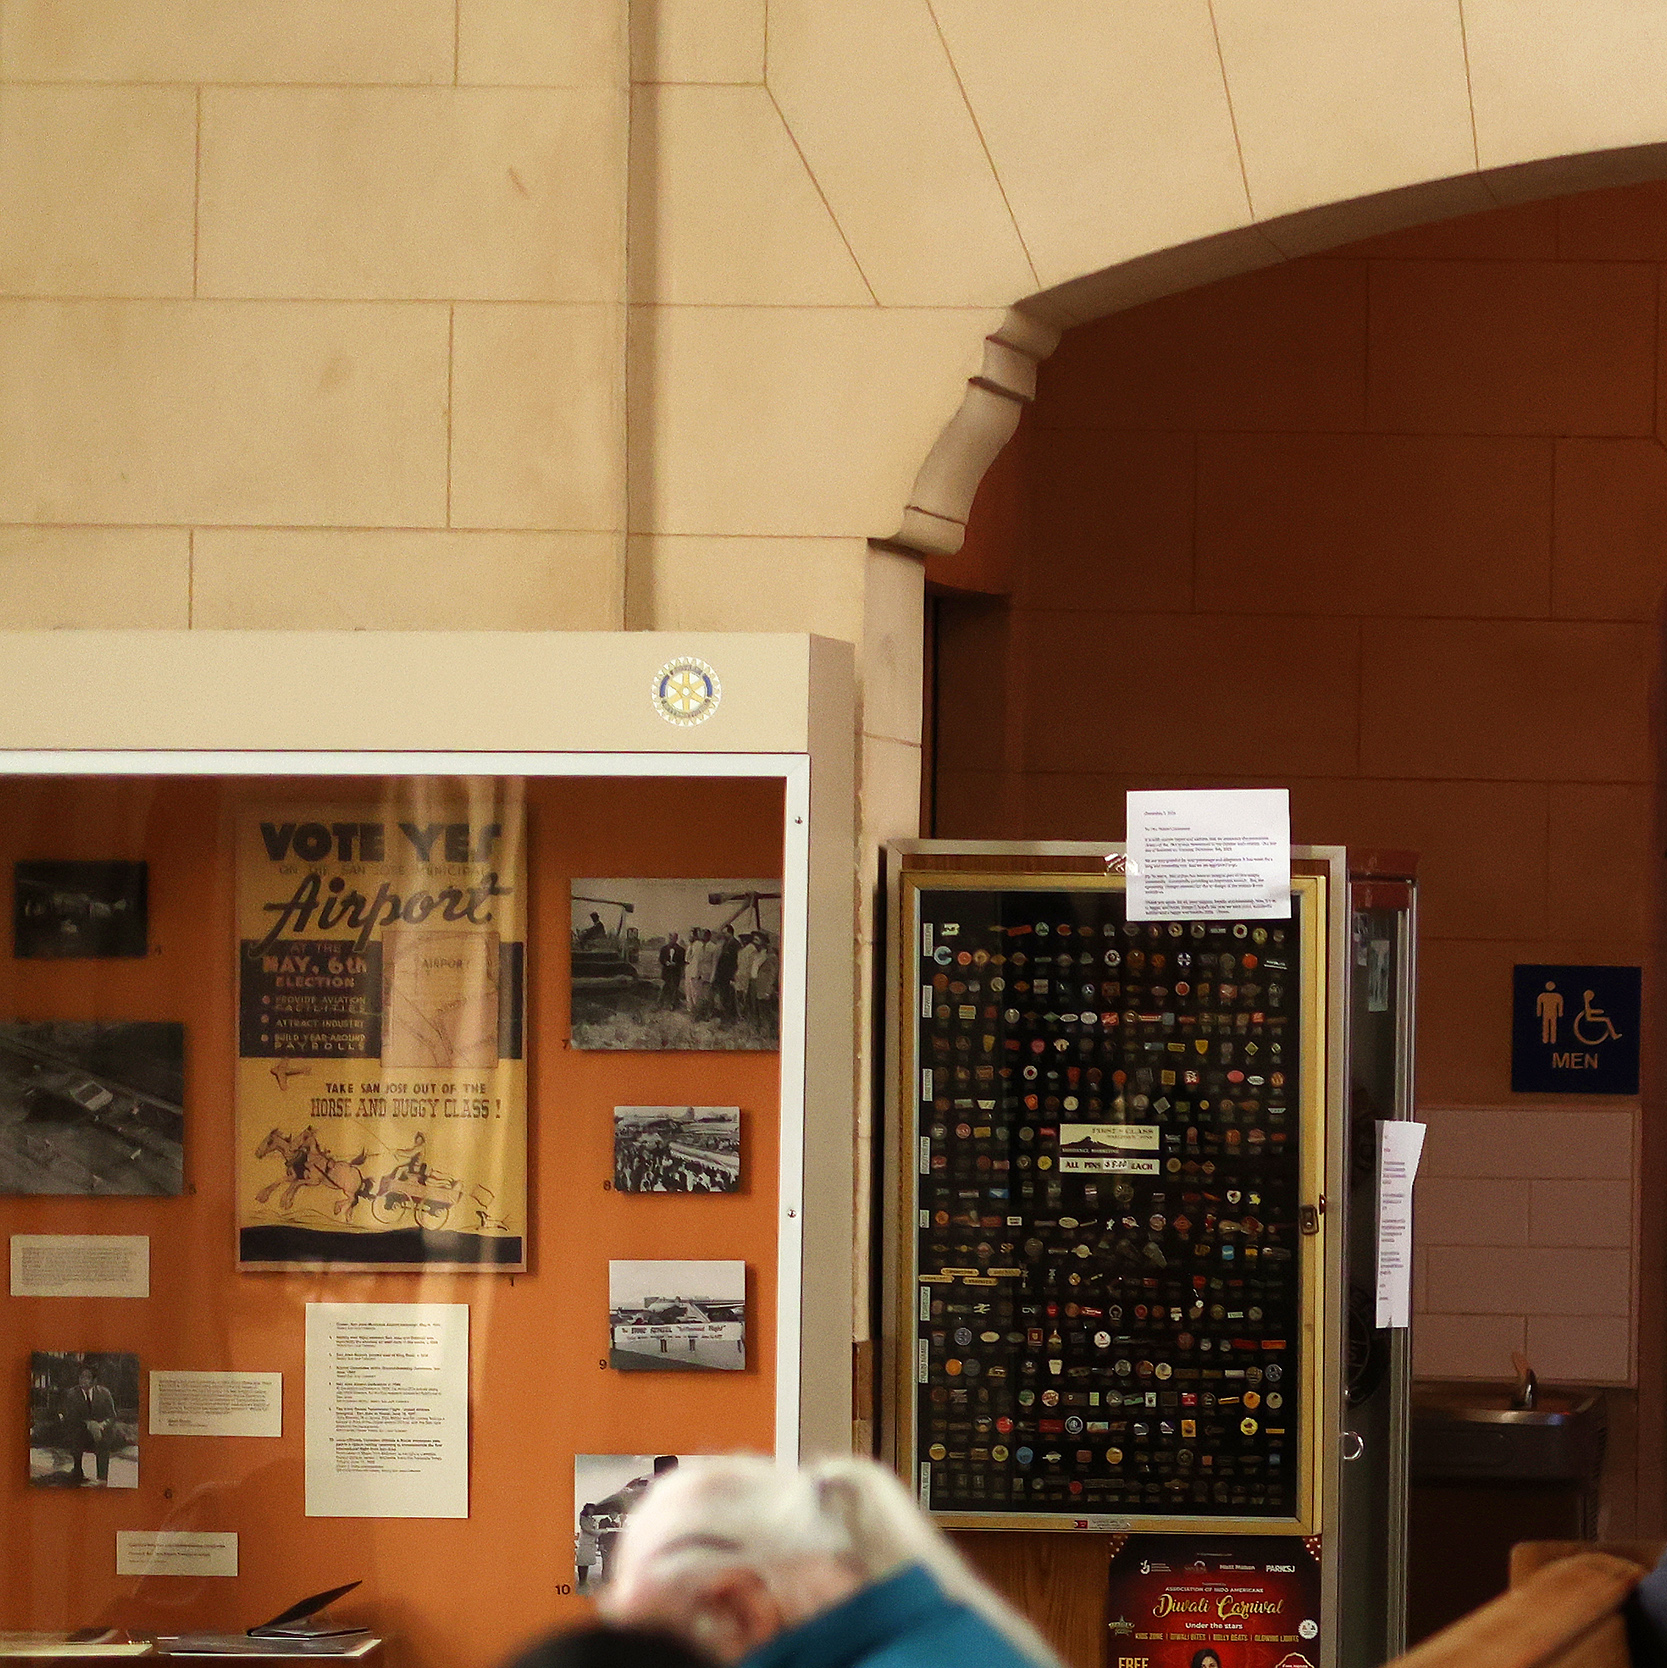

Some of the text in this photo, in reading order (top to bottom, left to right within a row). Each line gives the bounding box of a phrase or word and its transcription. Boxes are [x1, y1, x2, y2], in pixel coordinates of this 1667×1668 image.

[260, 822, 385, 862] VOTE
[249, 872, 513, 958] Airport
[328, 955, 367, 974] 6th
[276, 976, 355, 988] ELECTION
[562, 1039, 570, 1049] 7
[1552, 1052, 1599, 1069] MEN
[326, 1082, 354, 1094] TAKE
[361, 1082, 380, 1094] SAN
[413, 1082, 437, 1094] OUT
[464, 1082, 486, 1094] THE
[310, 1099, 353, 1118] HORSE
[356, 1099, 387, 1118] AND
[393, 1099, 440, 1118] BUGGY
[444, 1099, 489, 1119] CLASS
[1065, 1161, 1079, 1169] ALL
[1084, 1161, 1100, 1169] PINS
[1131, 1162, 1153, 1170] EACH
[603, 1180, 611, 1191] 8
[599, 1359, 607, 1370] 9
[555, 1584, 570, 1595] 10
[1153, 1594, 1284, 1620] Diwali Carnival
